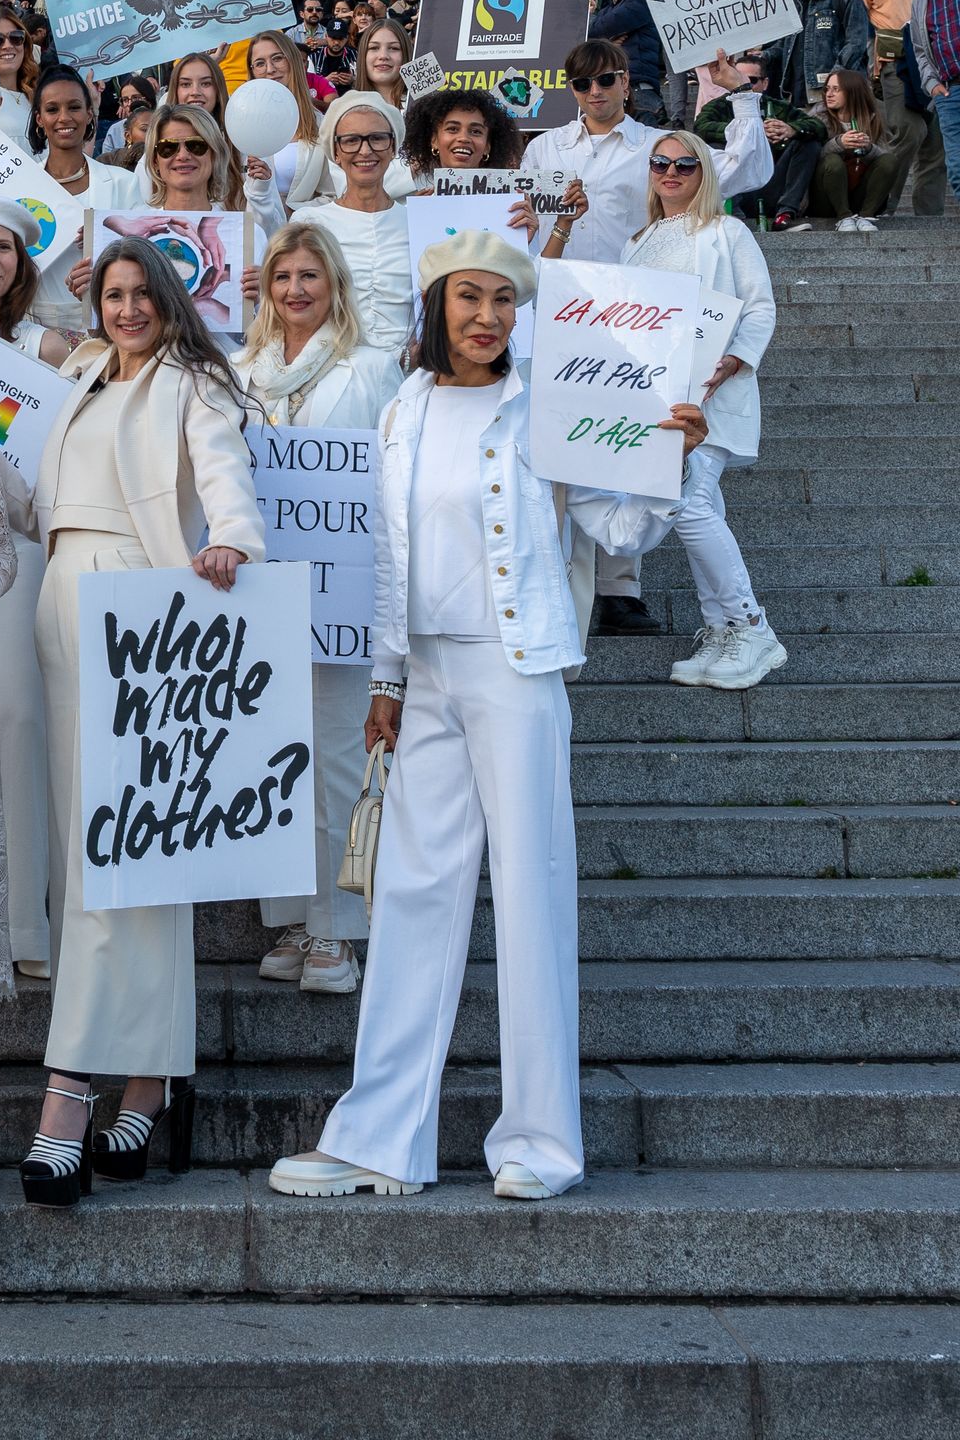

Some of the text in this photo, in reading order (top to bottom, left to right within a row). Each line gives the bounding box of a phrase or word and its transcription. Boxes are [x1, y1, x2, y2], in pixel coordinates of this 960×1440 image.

[55, 1, 126, 39] JUSTICE
[471, 33, 523, 43] FAIRTRADE
[12, 156, 23, 167] b
[554, 298, 683, 331] LA MODE
[553, 356, 667, 390] N'A PAS
[266, 437, 370, 473] MODE
[274, 497, 370, 534] POUR
[112, 615, 273, 737] made
[140, 726, 230, 792] my
[86, 742, 310, 867] clothes?
